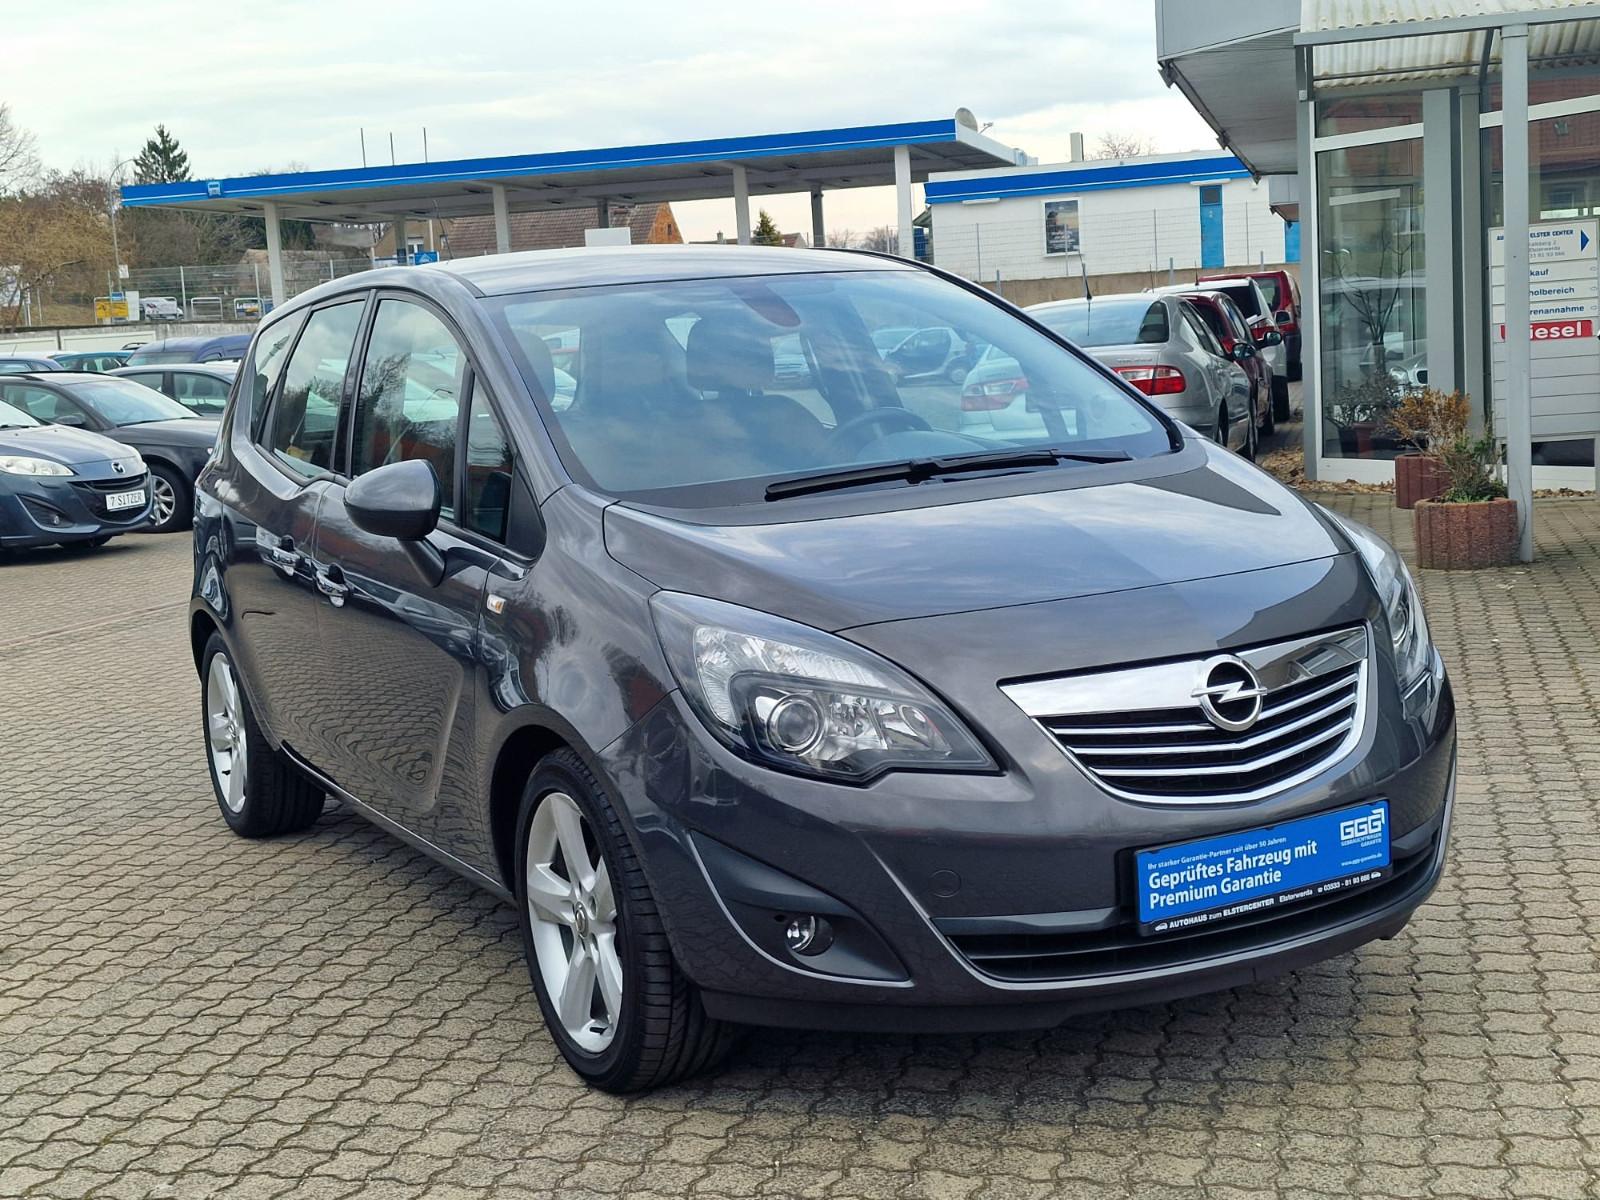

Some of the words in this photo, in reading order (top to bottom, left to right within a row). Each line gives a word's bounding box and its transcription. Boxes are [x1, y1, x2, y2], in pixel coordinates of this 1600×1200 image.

[1530, 268, 1549, 276] kauf
[1529, 287, 1575, 296] holbereich
[1530, 305, 1584, 315] renannahme
[1530, 321, 1582, 339] iesel
[111, 496, 115, 507] 7
[118, 491, 142, 506] SITZER
[1340, 813, 1382, 840] GGG
[1148, 862, 1157, 870] Ihr
[1158, 858, 1180, 868] starker
[1181, 848, 1232, 863] Garantie-Partner
[1233, 846, 1243, 854] seit
[1244, 842, 1258, 851] über
[1267, 837, 1287, 847] Jahren
[1149, 862, 1223, 889] Geprüftes
[1226, 848, 1291, 873] Fahrzeug
[1294, 840, 1318, 859] mit
[1150, 885, 1217, 910] Premium
[1221, 868, 1282, 894] Garantie
[1169, 913, 1208, 929] AUTOHAUS
[1208, 911, 1222, 920] zum
[1223, 898, 1275, 917] ELSTERCENTER
